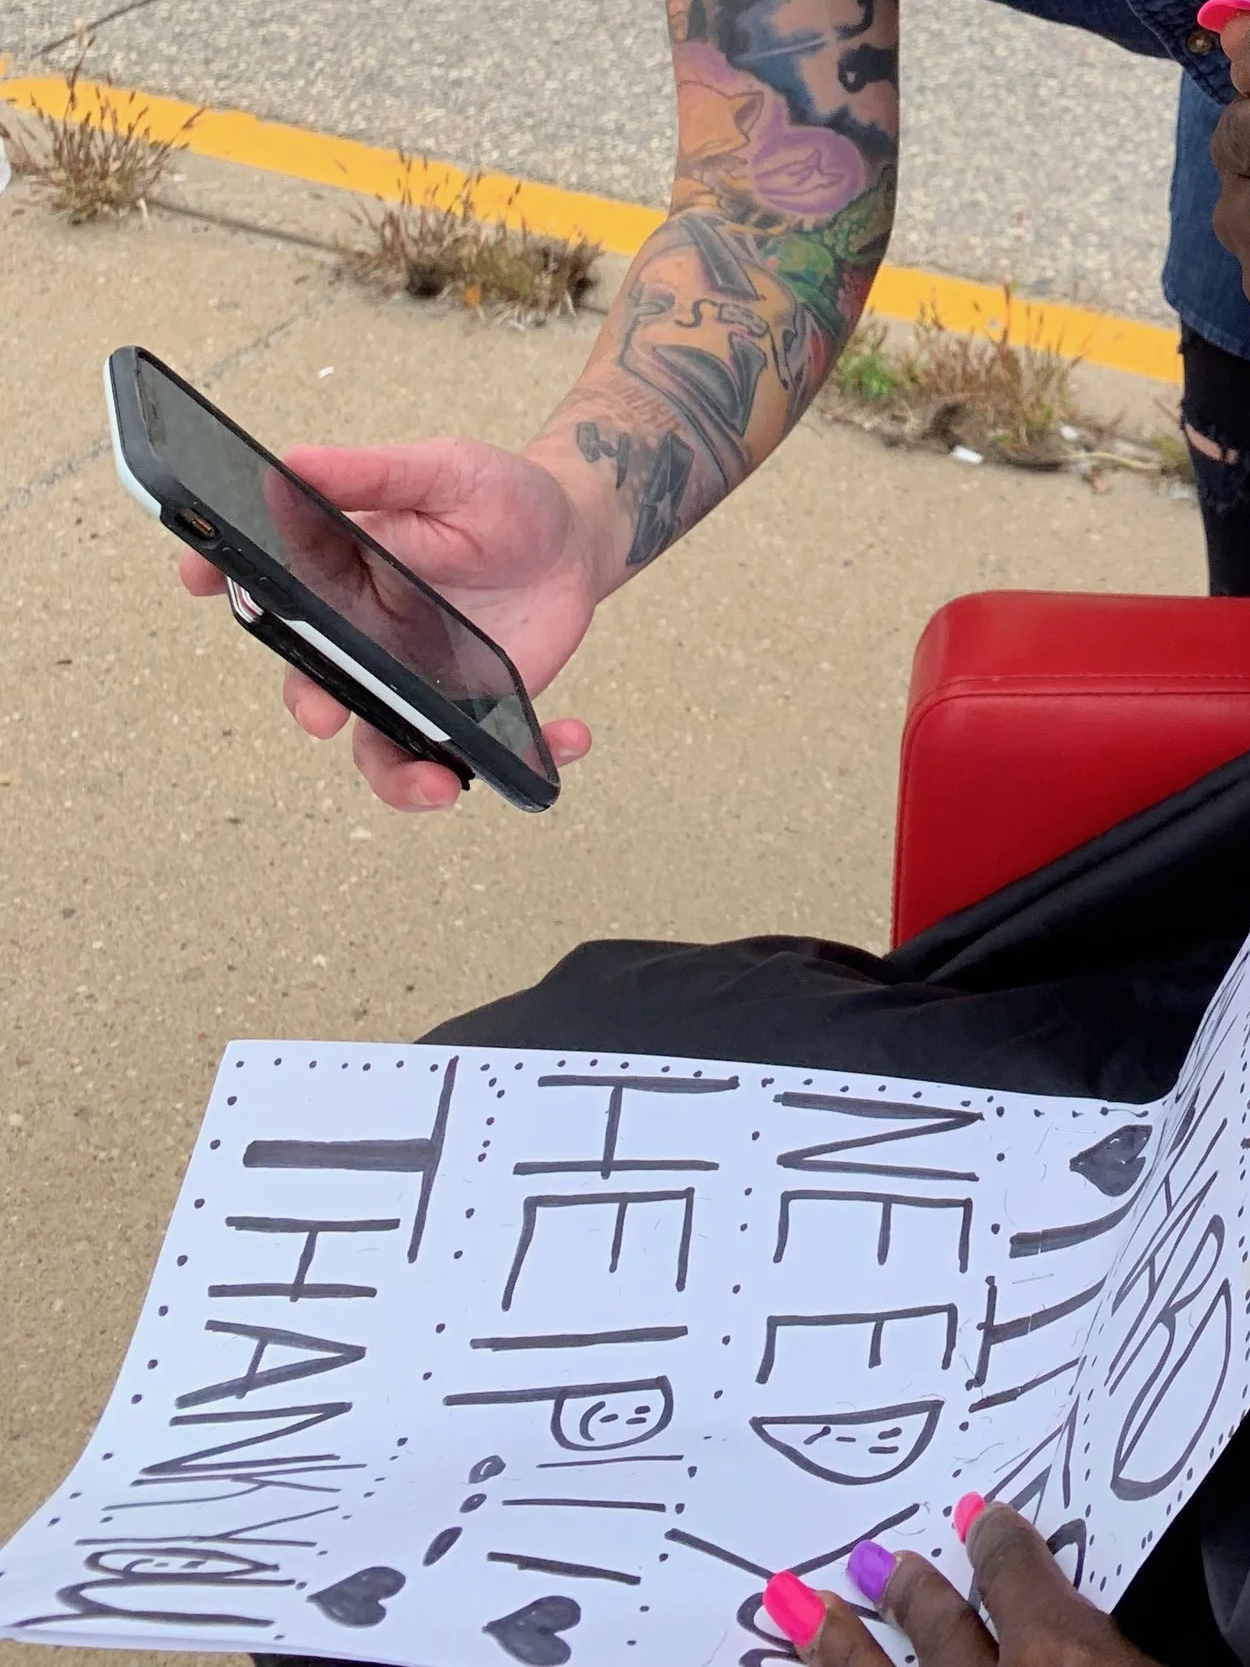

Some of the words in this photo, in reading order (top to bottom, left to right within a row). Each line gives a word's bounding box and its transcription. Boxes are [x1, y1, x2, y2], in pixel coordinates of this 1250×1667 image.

[102, 1055, 460, 1512] THANK
[750, 1091, 985, 1487] NEED
[1104, 1070, 1232, 1501] HARD
